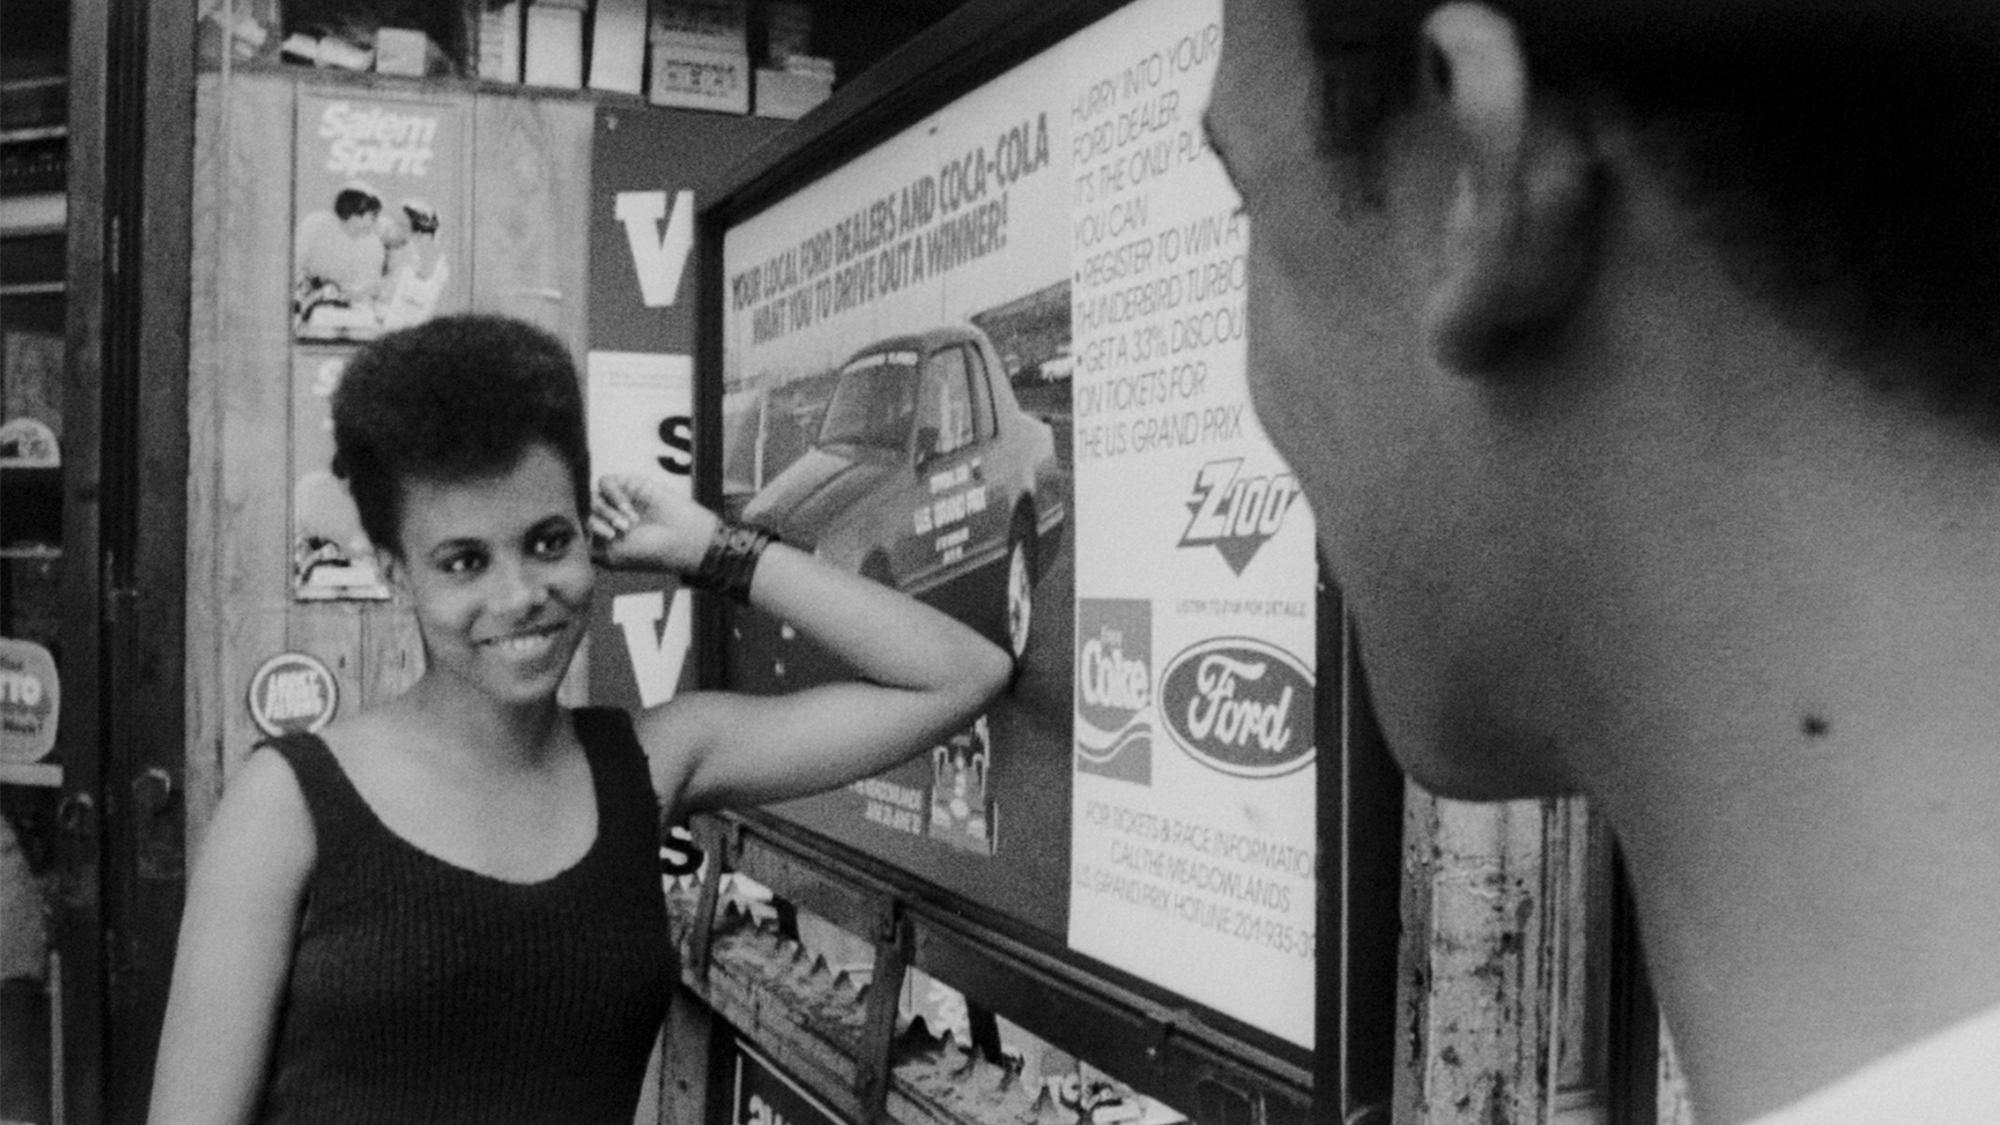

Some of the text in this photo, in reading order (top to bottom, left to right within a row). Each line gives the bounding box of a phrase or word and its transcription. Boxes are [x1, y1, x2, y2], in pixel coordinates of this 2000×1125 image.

[1071, 22, 1219, 126] HURRY INTO YOUR
[318, 101, 438, 147] Salem
[326, 137, 435, 178] Spirit
[1072, 89, 1180, 168] FORD DEALER
[1099, 156, 1126, 200] THE
[1128, 137, 1176, 187] ONLY
[732, 110, 1049, 313] YOUR LOCAL FORD DEALERS AND COCA-COLA
[1074, 194, 1149, 252] YOU CAN
[752, 189, 1009, 346] WANT YOU TO DRIVE OUT A WINNER!
[1083, 237, 1153, 288] REGISTER
[1156, 226, 1182, 266] TO
[1182, 214, 1223, 258] WIN
[1076, 252, 1248, 334] THUNDERBIRD TURBO
[1086, 300, 1248, 374] GET A 33% DISCOU
[1076, 359, 1208, 419] ON TICKETS FOR
[1077, 423, 1103, 460] THE
[1130, 410, 1199, 455] GRAND
[1202, 401, 1244, 444] PRIX
[1177, 457, 1300, 548] Z100
[1081, 637, 1150, 711] Coke
[1187, 653, 1294, 753] Ford
[1086, 800, 1111, 828] FOR
[1112, 805, 1159, 841] TICKETS
[1172, 819, 1211, 854] RACE
[1213, 829, 1313, 881] INFORMATIO
[1109, 839, 1291, 914] CALL THE MEADOWLANDS
[1095, 868, 1142, 905] GRAND
[1142, 880, 1172, 914] PRIX
[1174, 892, 1231, 936] HOTLINE
